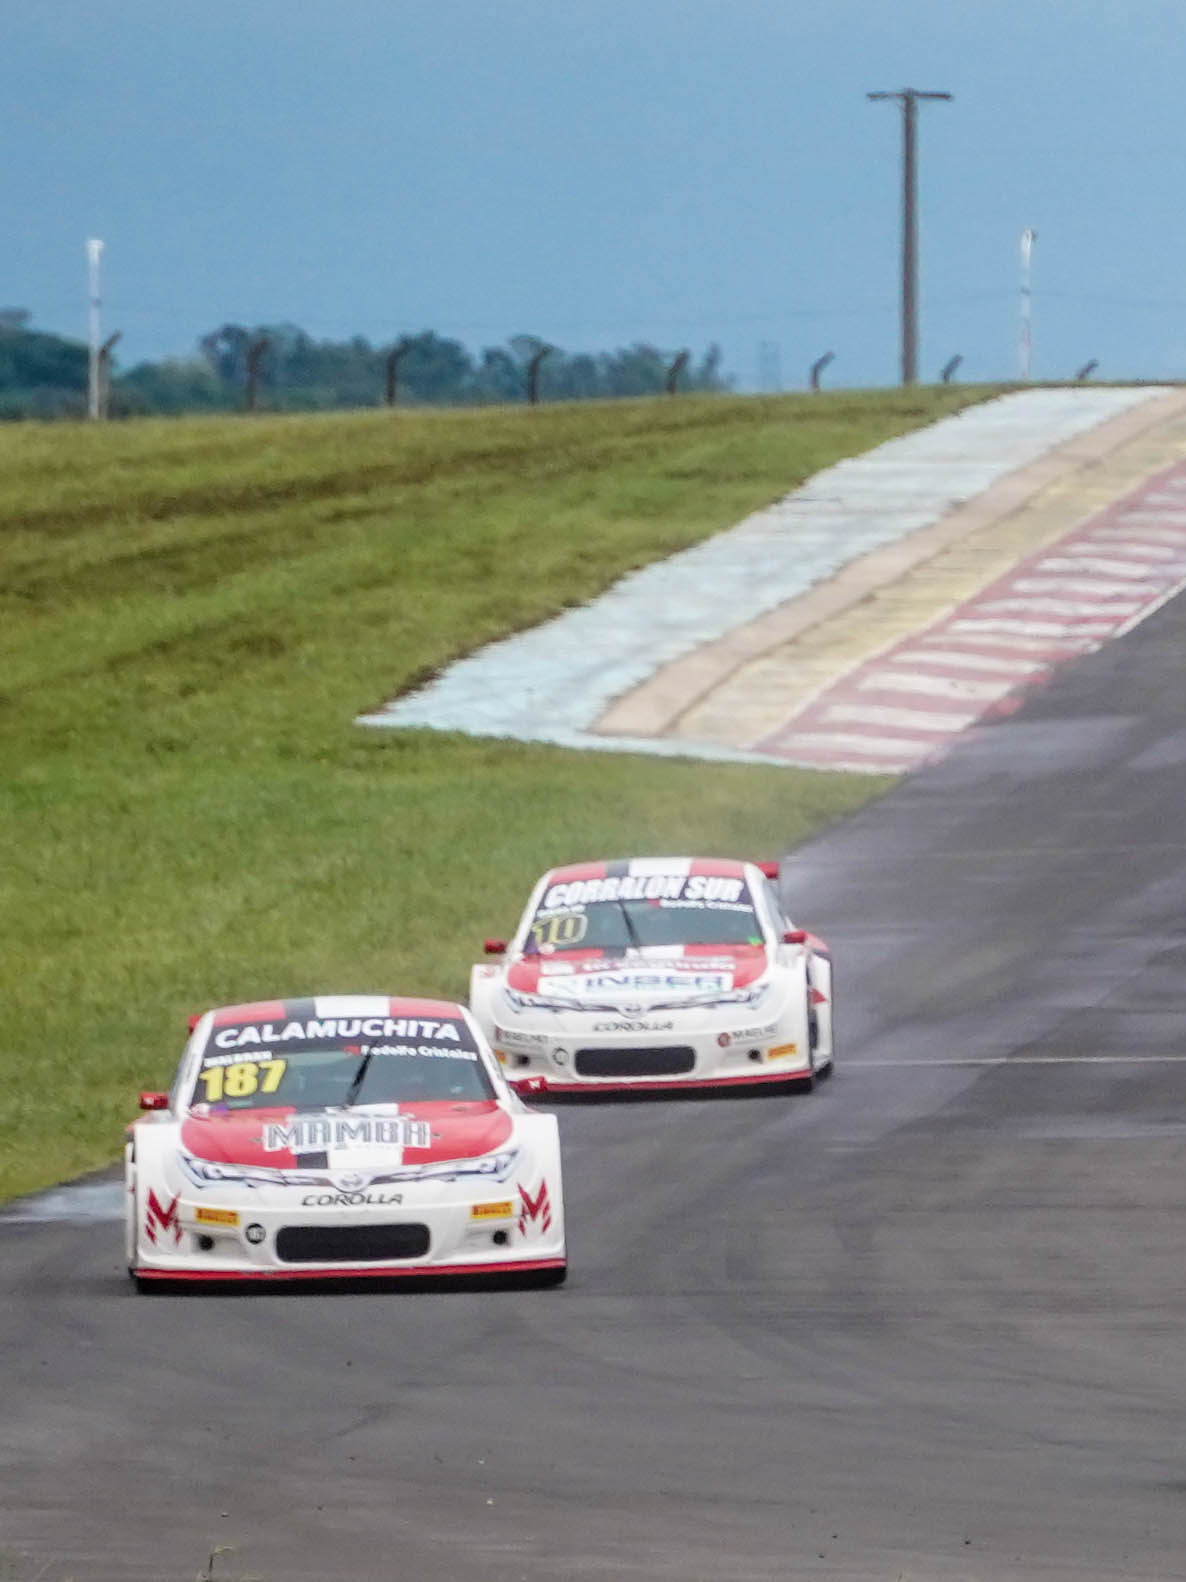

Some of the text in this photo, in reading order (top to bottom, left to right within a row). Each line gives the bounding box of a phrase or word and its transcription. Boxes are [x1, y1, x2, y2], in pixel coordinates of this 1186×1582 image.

[684, 876, 744, 901] SUR
[532, 913, 588, 945] 10
[215, 1019, 460, 1048] CALAMUCHITA
[593, 1021, 675, 1032] COROLLA
[200, 1059, 287, 1101] 187
[266, 1120, 427, 1149] MAMBA
[301, 1193, 404, 1207] COROLLA
